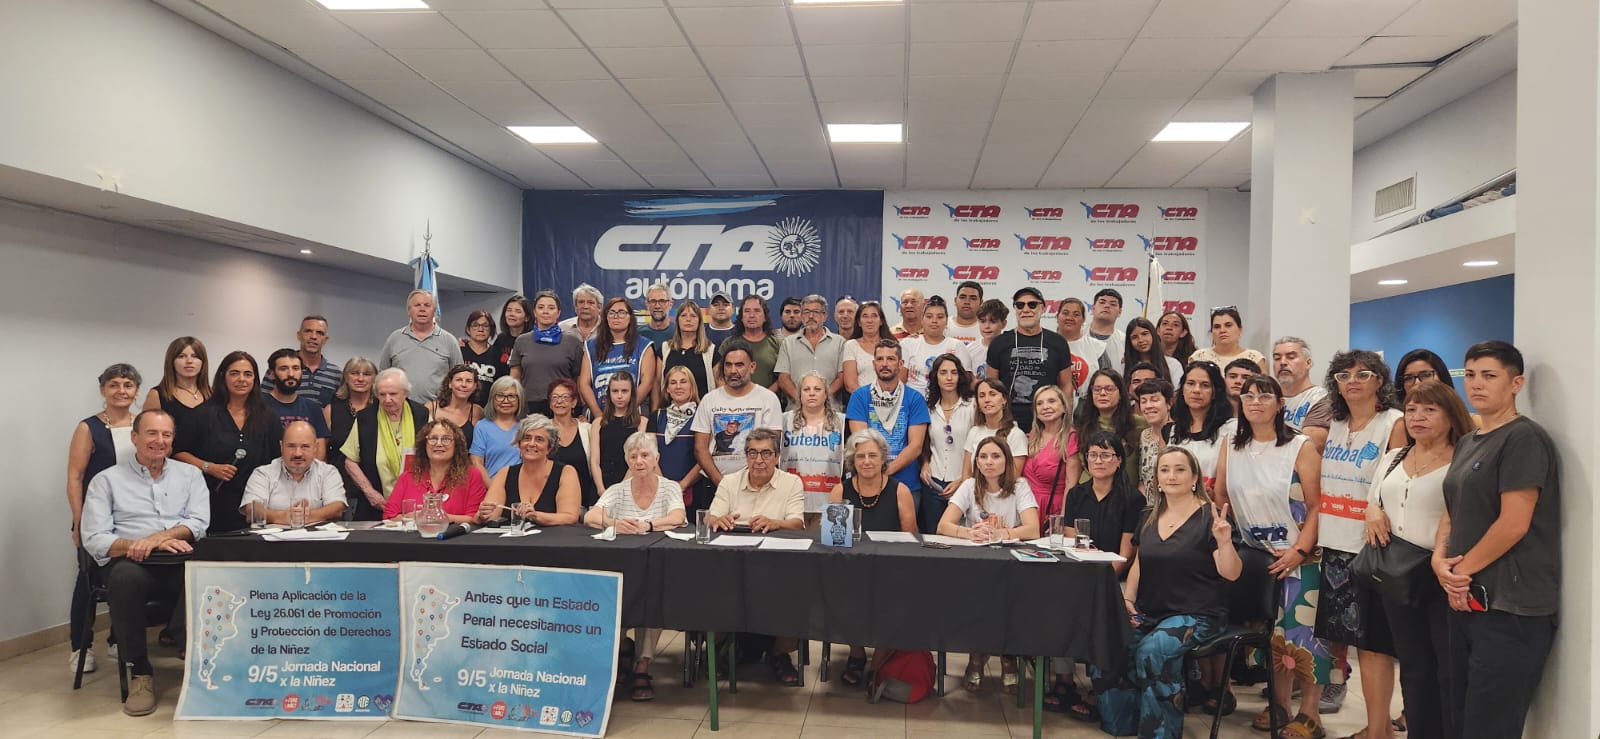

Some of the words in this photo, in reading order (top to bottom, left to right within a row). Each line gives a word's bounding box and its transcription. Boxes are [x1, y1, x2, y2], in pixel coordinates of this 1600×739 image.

[900, 206, 931, 216] CTA
[954, 205, 1001, 218] CTA
[1032, 208, 1064, 217] CTA
[1091, 204, 1140, 218] CTA
[1164, 207, 1198, 217] CTA
[594, 225, 777, 271] CTA
[904, 236, 949, 250] CTA
[970, 238, 1000, 248] CTA
[1025, 236, 1072, 250] CTA
[1092, 238, 1125, 248] CTA
[899, 268, 930, 278] CTA
[953, 266, 1000, 280] CTA
[1030, 270, 1062, 280] CTA
[1090, 267, 1138, 281] CTA
[1163, 271, 1196, 281] CTA
[625, 272, 774, 300] autónoma
[784, 431, 828, 448] Suteba
[250, 590, 278, 600] Plena
[282, 590, 337, 603] Aplicación
[340, 591, 353, 600] de
[357, 591, 366, 600] la
[464, 590, 502, 605] Antes
[506, 595, 531, 608] que
[535, 598, 549, 608] un
[552, 597, 600, 612] Estado
[251, 608, 270, 620] Ley
[273, 609, 304, 618] 26.061
[308, 608, 321, 618] de
[324, 608, 382, 619] Promoción
[463, 613, 496, 627] Penal
[500, 618, 582, 634] necesitamos
[586, 625, 601, 635] un
[251, 629, 258, 638] y
[261, 626, 320, 636] Protección
[324, 627, 337, 636] de
[340, 626, 391, 637] Derechos
[251, 645, 264, 654] de
[267, 645, 277, 654] la
[280, 644, 310, 655] Niñez
[461, 637, 507, 651] Estado
[510, 639, 548, 654] Social
[281, 661, 329, 672] Jornada
[331, 661, 381, 672] Nacional
[248, 664, 278, 683] 9/5
[458, 668, 487, 688] 9/5
[490, 668, 533, 682] Jornada
[536, 671, 586, 686] Nacional
[280, 678, 287, 686] x
[290, 676, 300, 686] la
[303, 675, 336, 687] Niñez
[488, 684, 495, 692] x
[498, 682, 507, 694] la
[510, 684, 541, 698] Niñez
